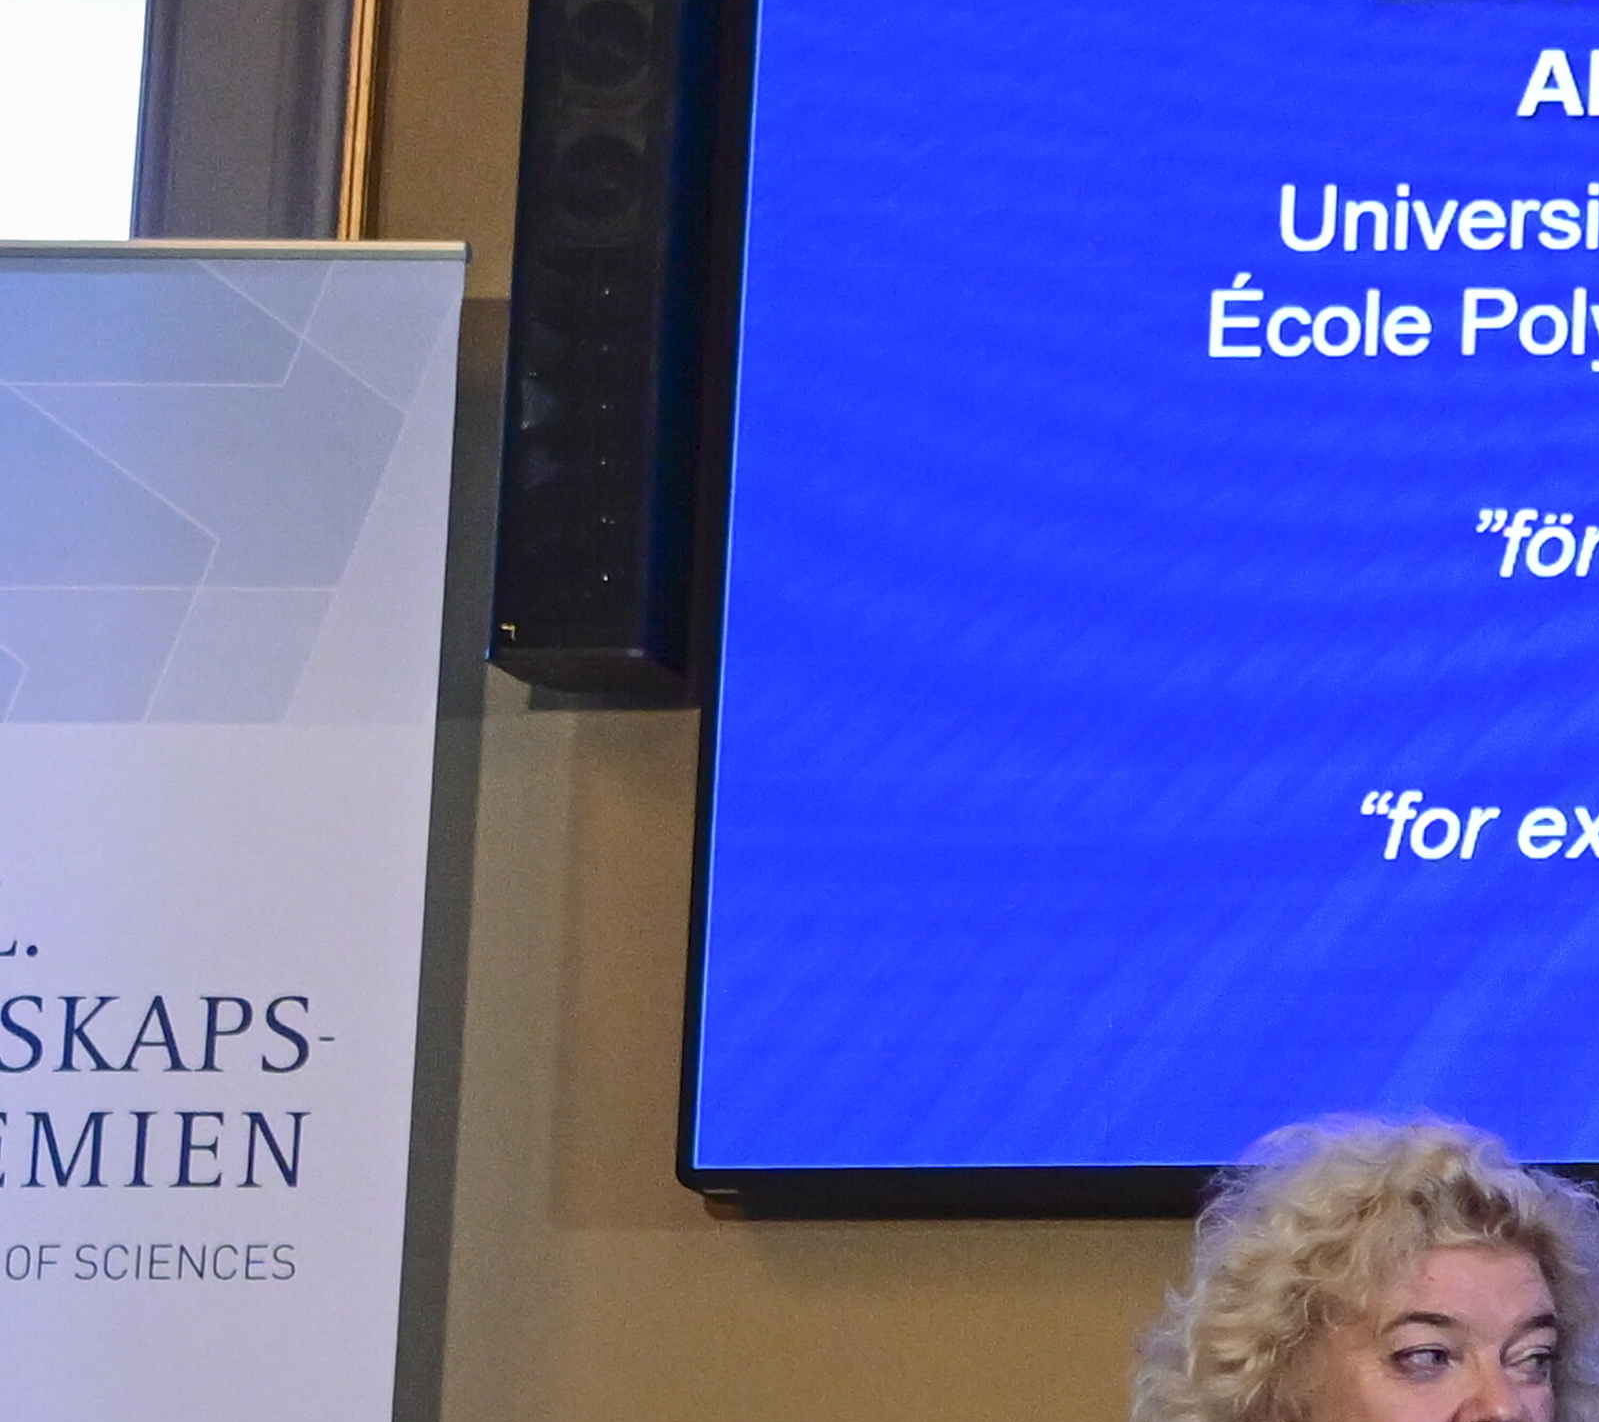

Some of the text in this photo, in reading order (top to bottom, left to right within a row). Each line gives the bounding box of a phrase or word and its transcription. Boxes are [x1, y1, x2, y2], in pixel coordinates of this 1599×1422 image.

[1207, 271, 1433, 359] École
[1359, 789, 1502, 861] “for
[0, 994, 336, 1075] SKAPS-
[0, 1110, 312, 1189] MIEN
[4, 1242, 297, 1282] OF SCIENCES
